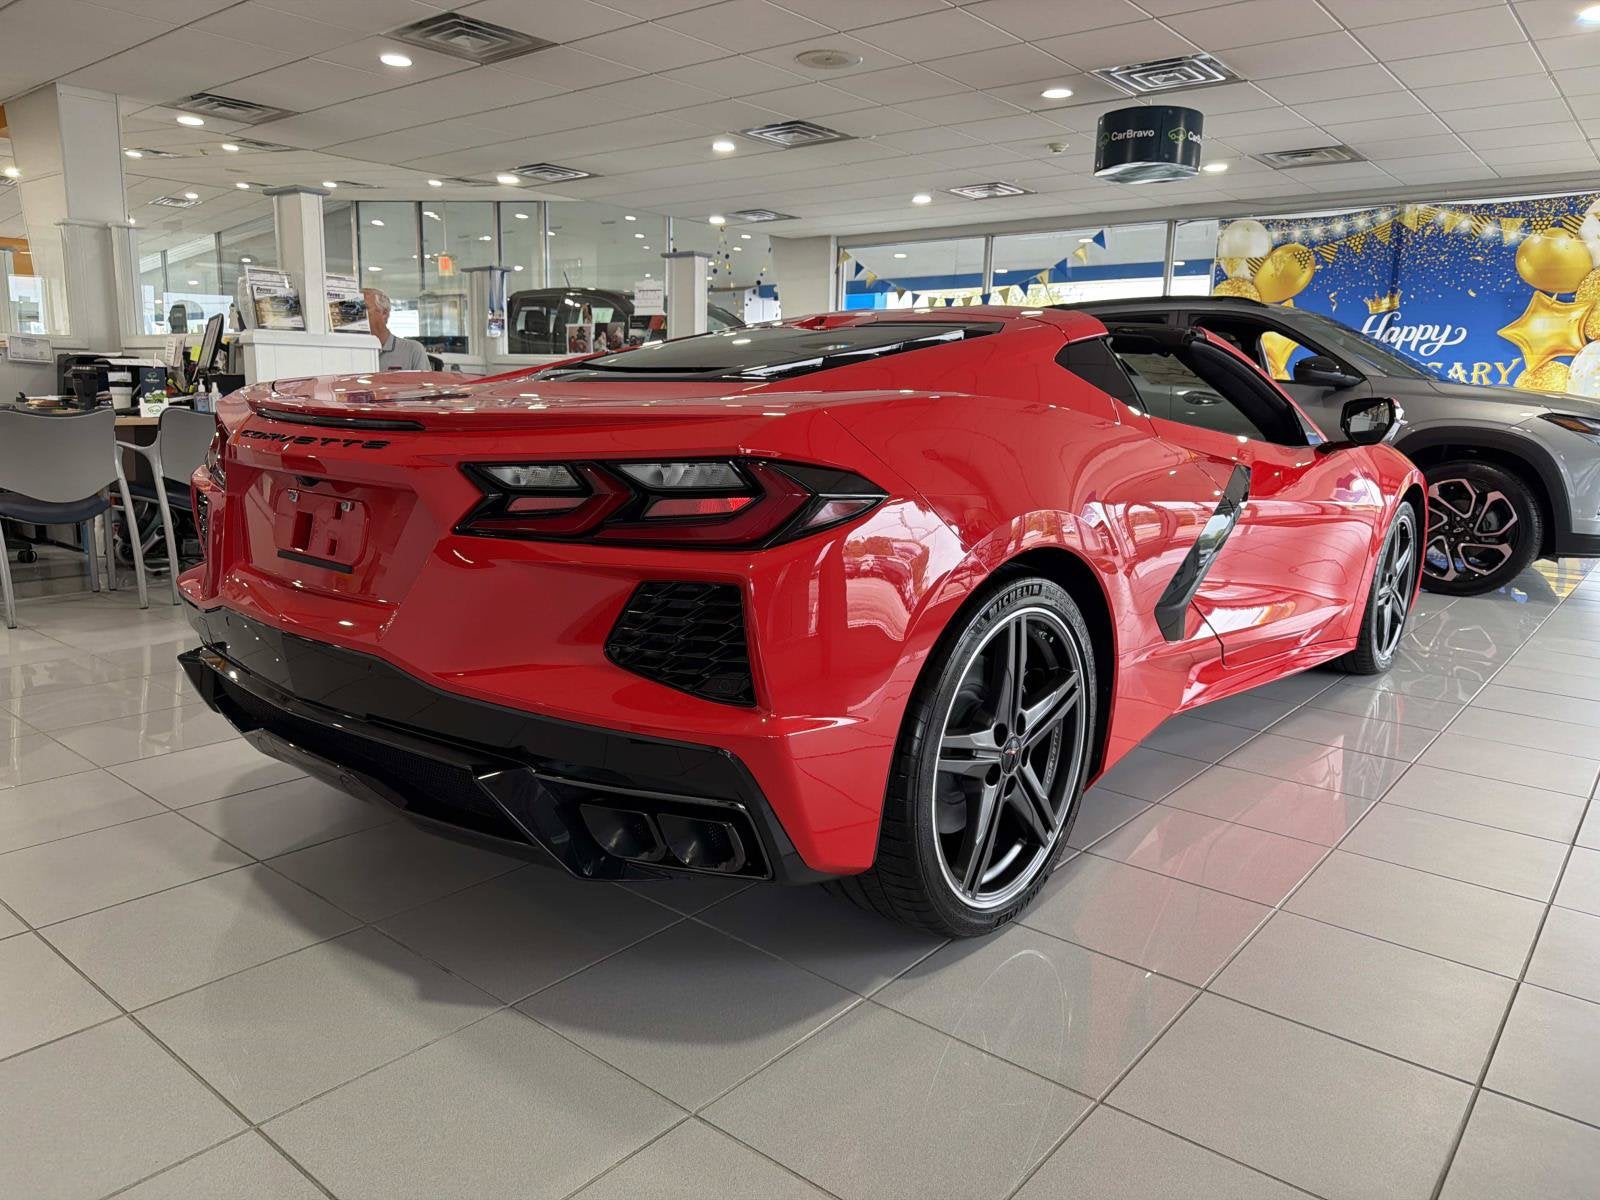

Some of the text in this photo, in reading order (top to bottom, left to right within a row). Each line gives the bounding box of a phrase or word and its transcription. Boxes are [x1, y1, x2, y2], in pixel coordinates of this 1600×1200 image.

[1111, 129, 1155, 141] CarBravo
[1361, 311, 1467, 356] Happy
[240, 429, 391, 449] CORVETTE
[989, 584, 1042, 618] MICHELIN
